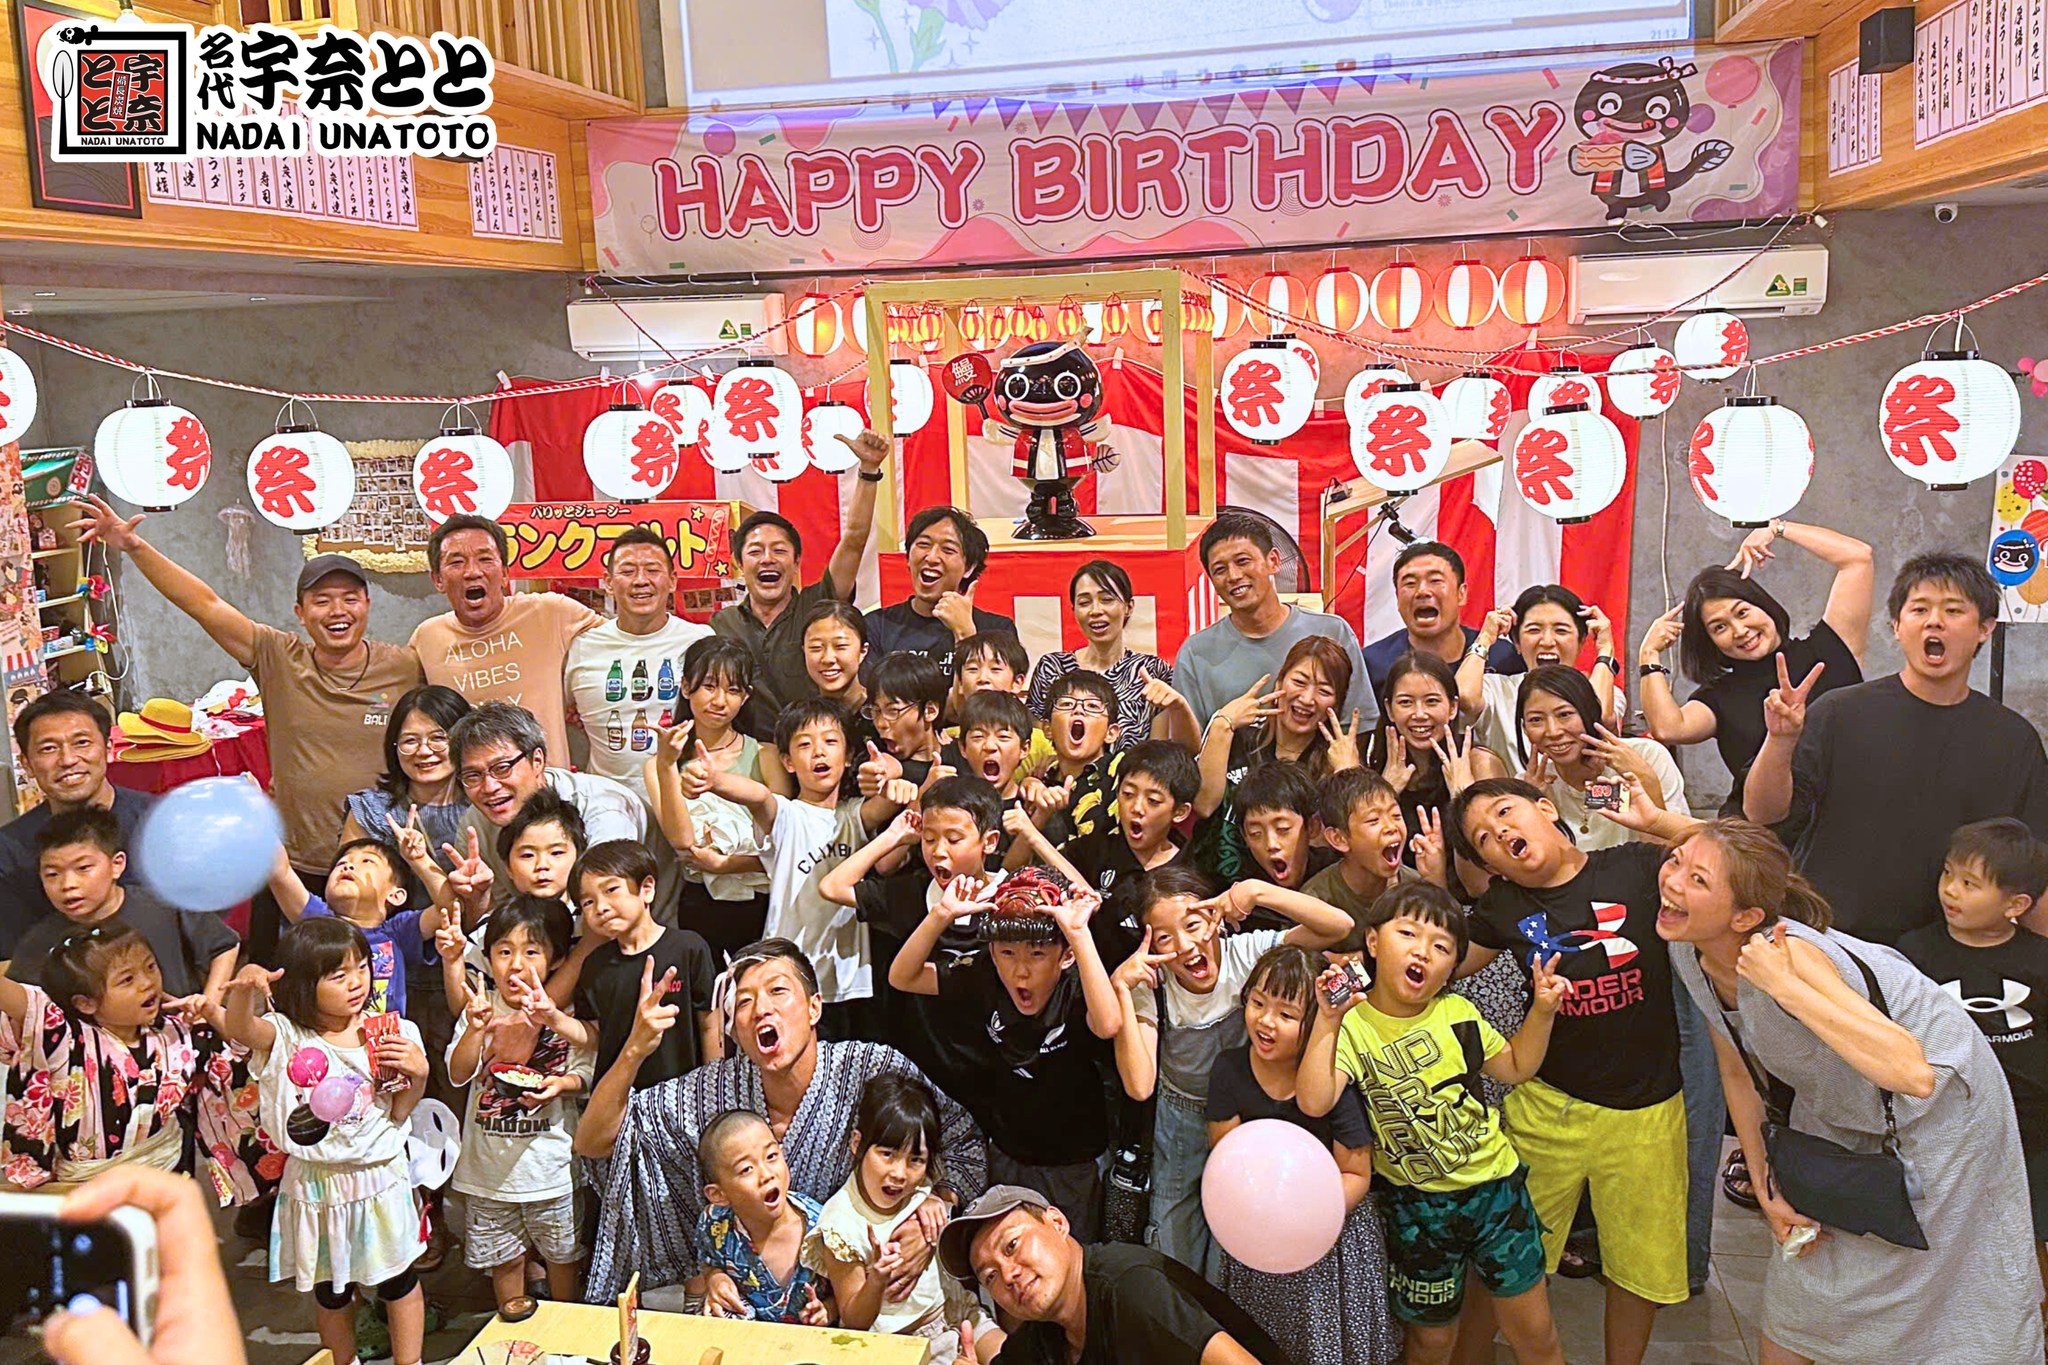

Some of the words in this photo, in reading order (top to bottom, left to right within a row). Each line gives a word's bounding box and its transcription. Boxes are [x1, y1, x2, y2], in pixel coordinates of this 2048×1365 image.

[652, 140, 985, 241] HAPPY
[1009, 100, 1565, 226] BIRTHDAY
[724, 376, 780, 442] 祭
[1228, 360, 1285, 427] 祭
[1883, 374, 1961, 467] 祭
[1366, 404, 1432, 478] 祭
[1515, 427, 1574, 506] 祭
[254, 445, 316, 518] 祭
[420, 447, 478, 514] 祭
[530, 504, 631, 519] バリッとジューシー
[444, 630, 523, 664] ALOHA
[453, 662, 521, 693] VIBES
[363, 713, 388, 726] BALI
